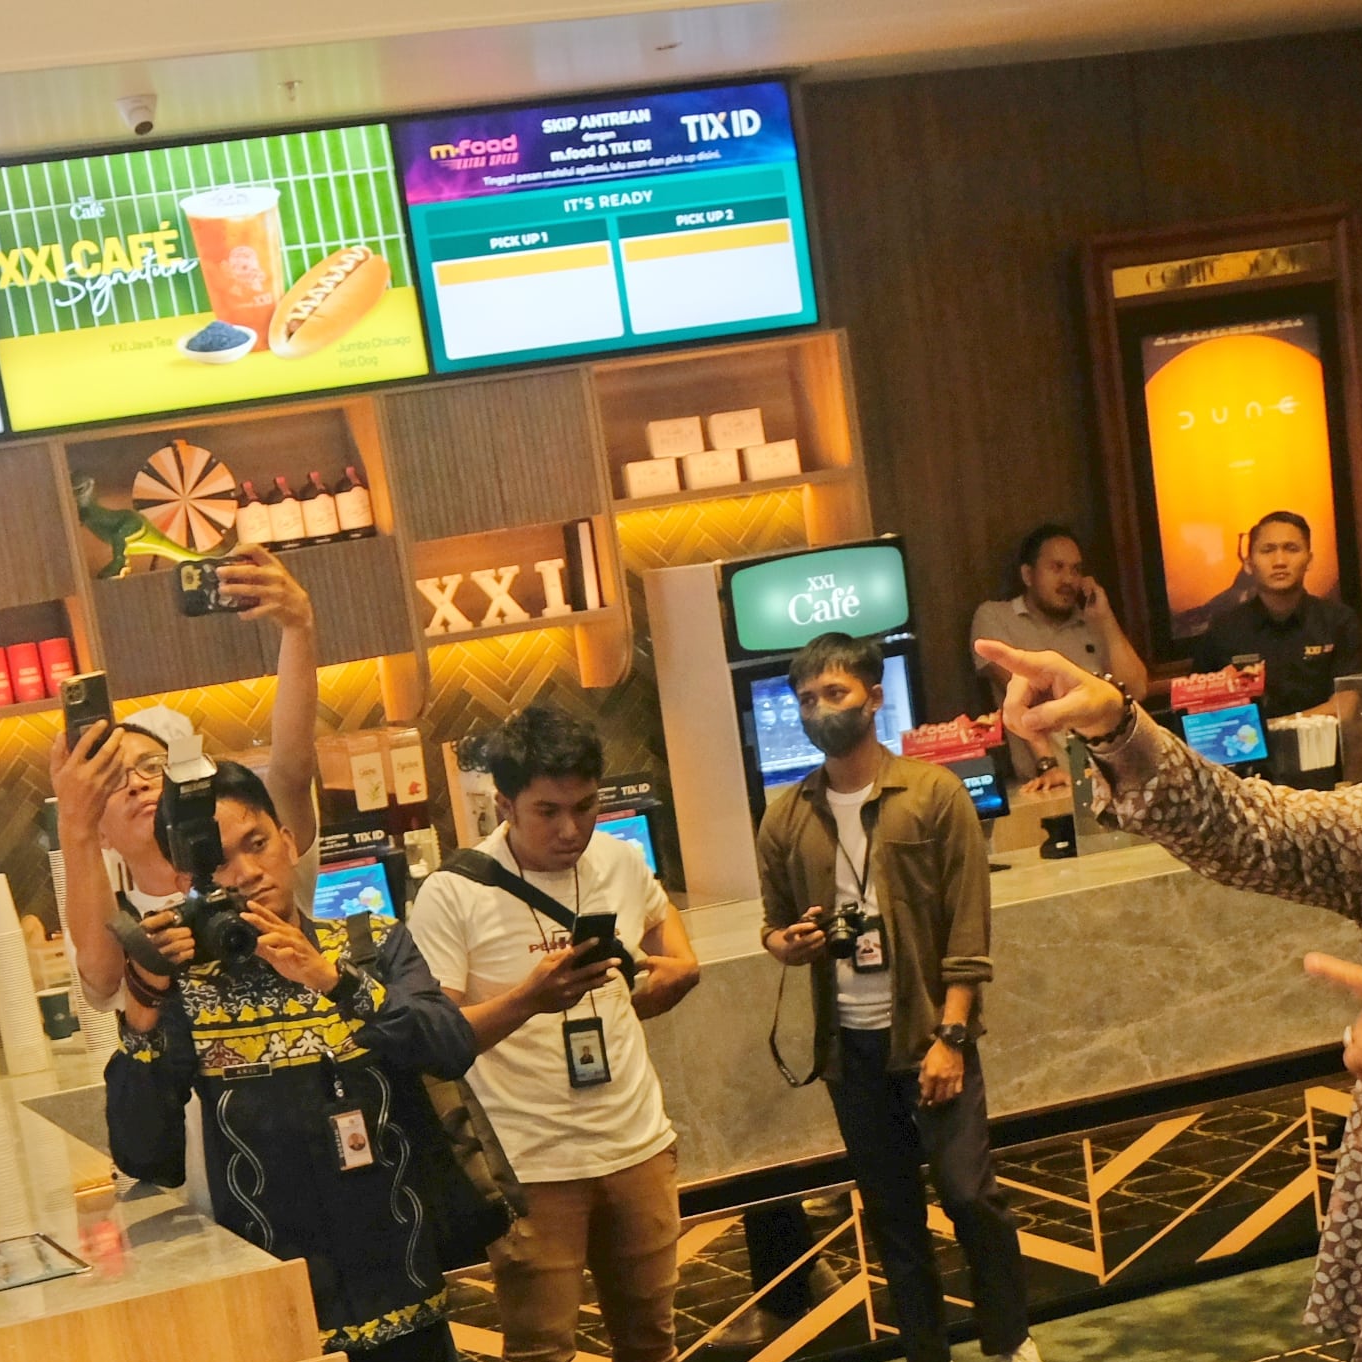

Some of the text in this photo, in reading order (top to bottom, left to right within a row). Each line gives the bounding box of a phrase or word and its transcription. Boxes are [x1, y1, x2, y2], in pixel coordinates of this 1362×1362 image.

[542, 108, 651, 134] SKIP ANTREAN
[680, 108, 761, 143] TIX ID
[581, 130, 617, 142] dengan
[550, 145, 596, 162] m.food
[609, 141, 632, 155] TIX
[69, 200, 106, 221] Café
[564, 190, 653, 212] IT'S READY
[676, 209, 734, 227] PICK UP 2
[69, 221, 182, 279] CAFÉ
[490, 231, 548, 249] PICK UP 1
[55, 248, 199, 317] Signature
[155, 336, 174, 348] Tea
[807, 574, 836, 593] XXI
[414, 558, 573, 636] XXI
[787, 585, 861, 628] Café
